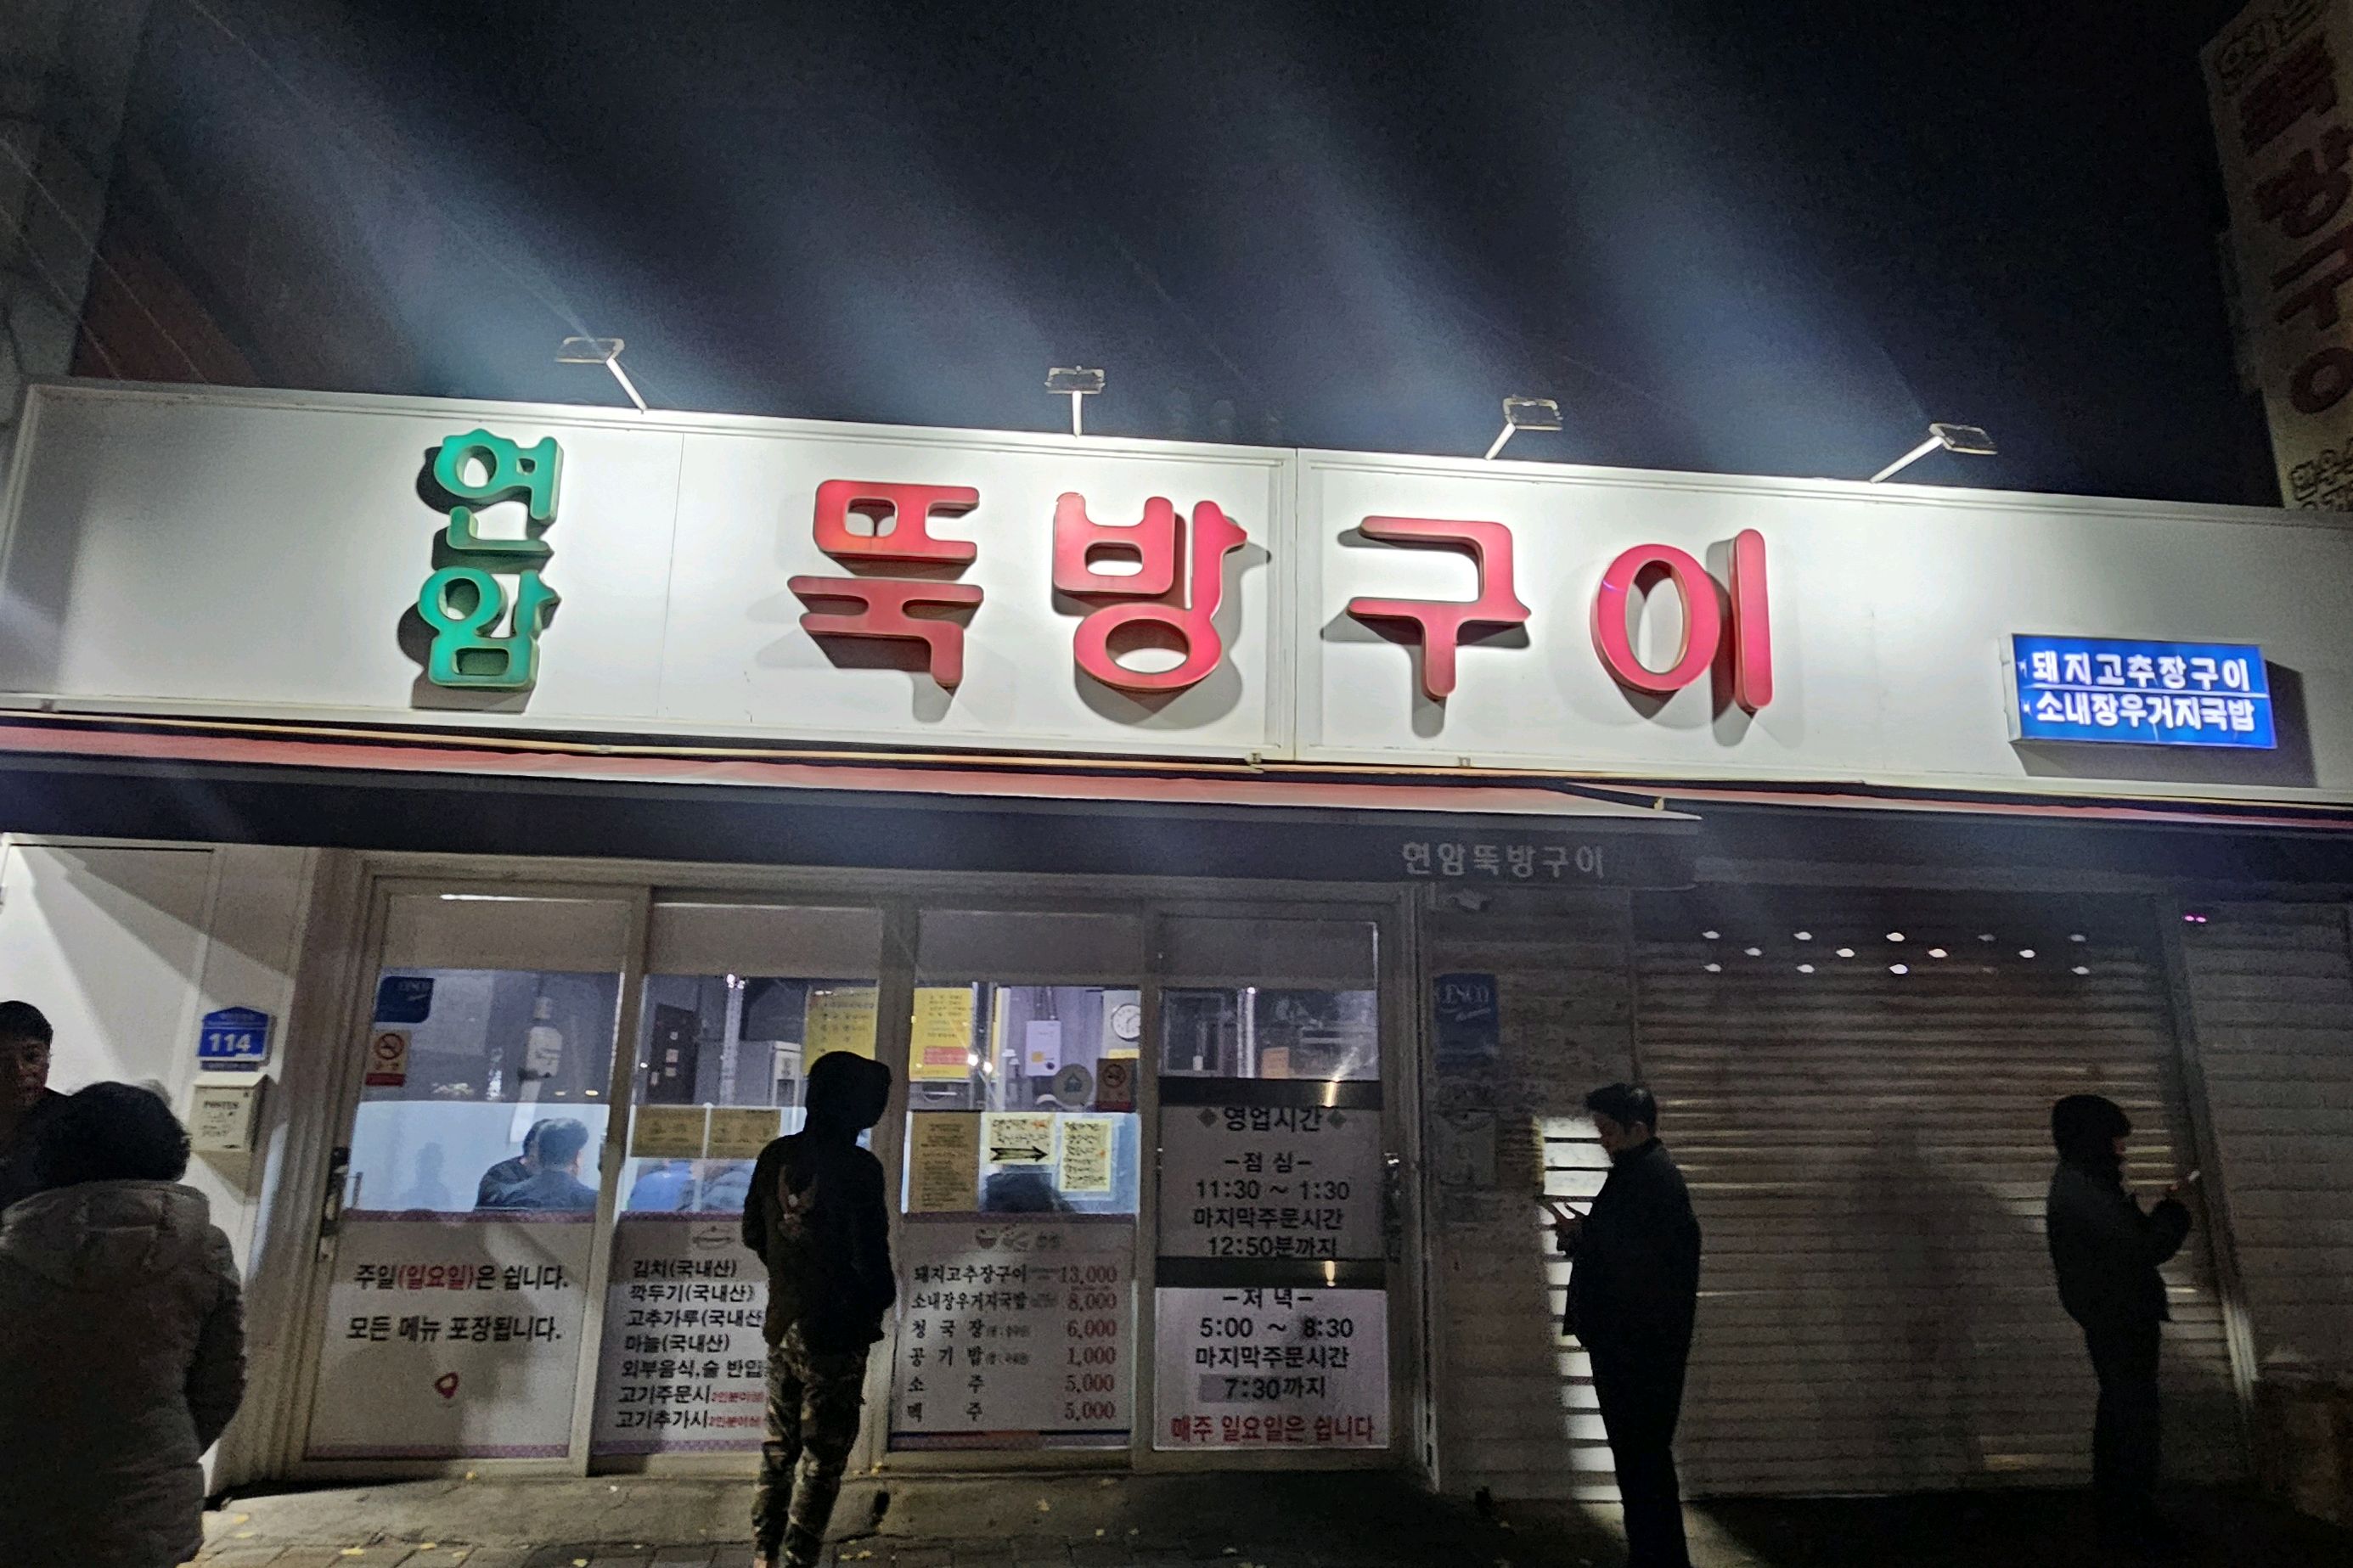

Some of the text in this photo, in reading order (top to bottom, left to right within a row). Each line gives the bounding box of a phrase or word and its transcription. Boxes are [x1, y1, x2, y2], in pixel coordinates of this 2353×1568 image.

[416, 427, 563, 688] 연암
[786, 478, 1774, 714] 뚝방구이
[2031, 650, 2251, 693] 돼지고추장구이
[2036, 692, 2255, 732] 소내장우거지국밥
[209, 1032, 251, 1053] 114
[1223, 1105, 1321, 1132] 영업시간
[1196, 1179, 1261, 1200] 11:30
[1299, 1180, 1350, 1201] 1:30
[1193, 1206, 1345, 1231] 마지막주문시간
[1207, 1236, 1338, 1257] 12:50분까지
[353, 1264, 570, 1290] 주일(일요일)은 쉽니다.
[633, 1259, 737, 1279] 김치(국내산)
[914, 1264, 1027, 1284] 돼지고추장구이
[628, 1284, 755, 1303] 깍두기(국내산)
[346, 1316, 562, 1342] 모든 메뉴 포장됩니다.
[1200, 1317, 1253, 1338] 5:00
[1303, 1318, 1354, 1339] 8:30
[625, 1334, 729, 1353] 마늘(국내산)
[1195, 1346, 1350, 1369] 마지막주문시간
[618, 1385, 710, 1404] 고기주문시
[1224, 1376, 1326, 1399] 7:30까지
[616, 1410, 708, 1430] 고기추가시
[1170, 1415, 1374, 1442] 매주 일요일은 쉽니다
